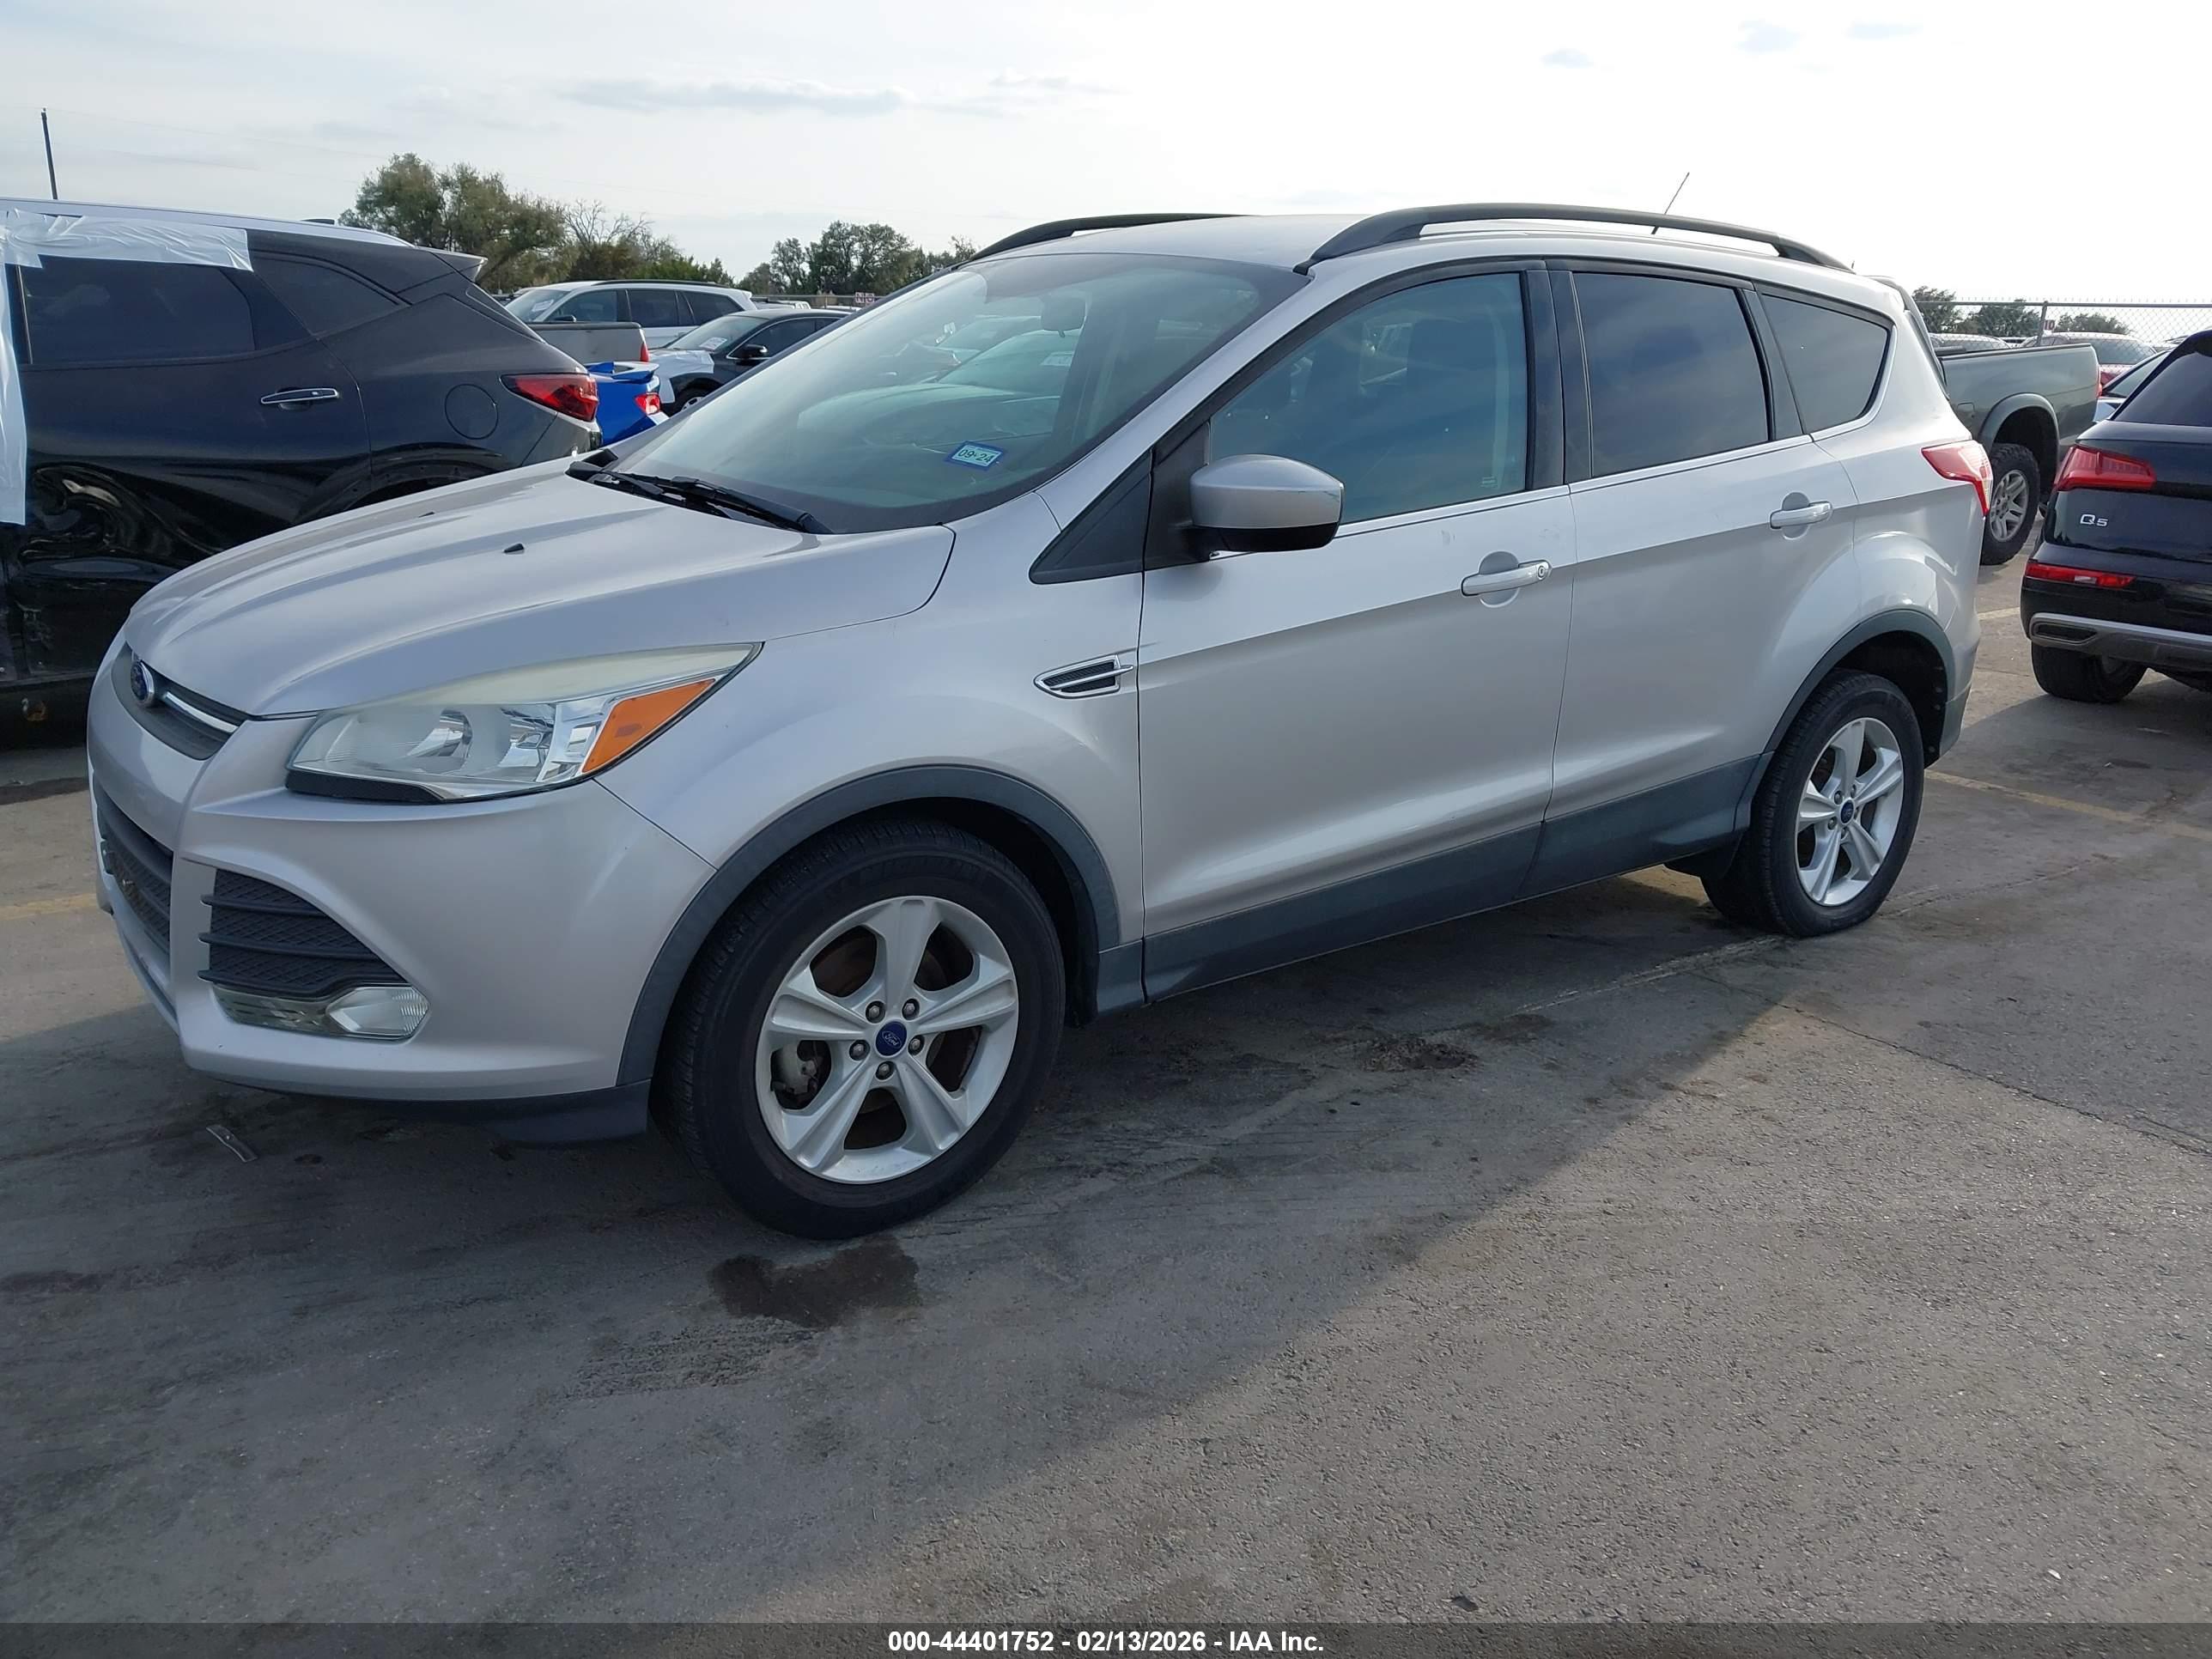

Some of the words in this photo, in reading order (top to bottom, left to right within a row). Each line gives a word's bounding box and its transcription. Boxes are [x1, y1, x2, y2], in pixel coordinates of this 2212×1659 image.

[957, 449, 975, 459] 09
[975, 453, 995, 463] 24
[2080, 514, 2109, 527] Q5
